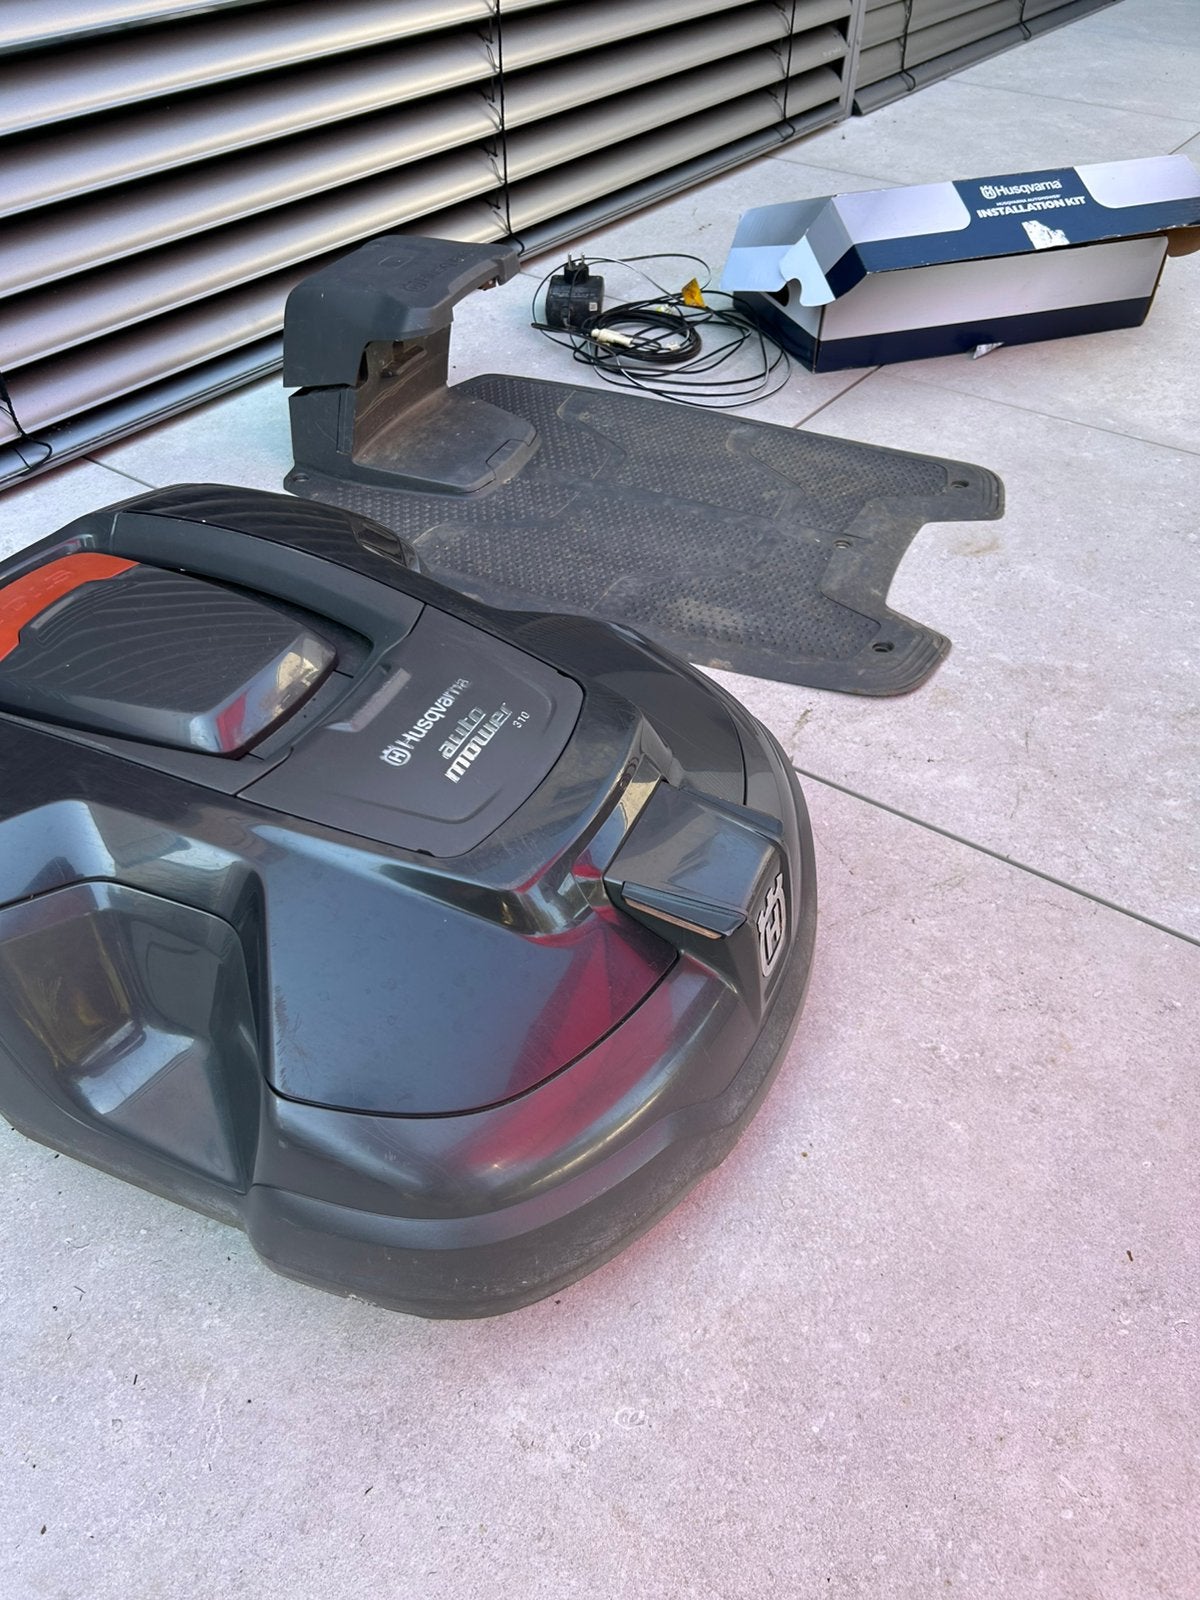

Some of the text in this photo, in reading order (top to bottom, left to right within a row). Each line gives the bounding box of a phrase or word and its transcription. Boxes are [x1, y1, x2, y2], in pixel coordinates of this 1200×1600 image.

[976, 196, 1086, 218] INSTALLATION KIT
[995, 180, 1062, 196] Husqvarna
[395, 678, 470, 750] Husqvarna
[438, 706, 486, 759] auto
[445, 702, 530, 783] mower 310
